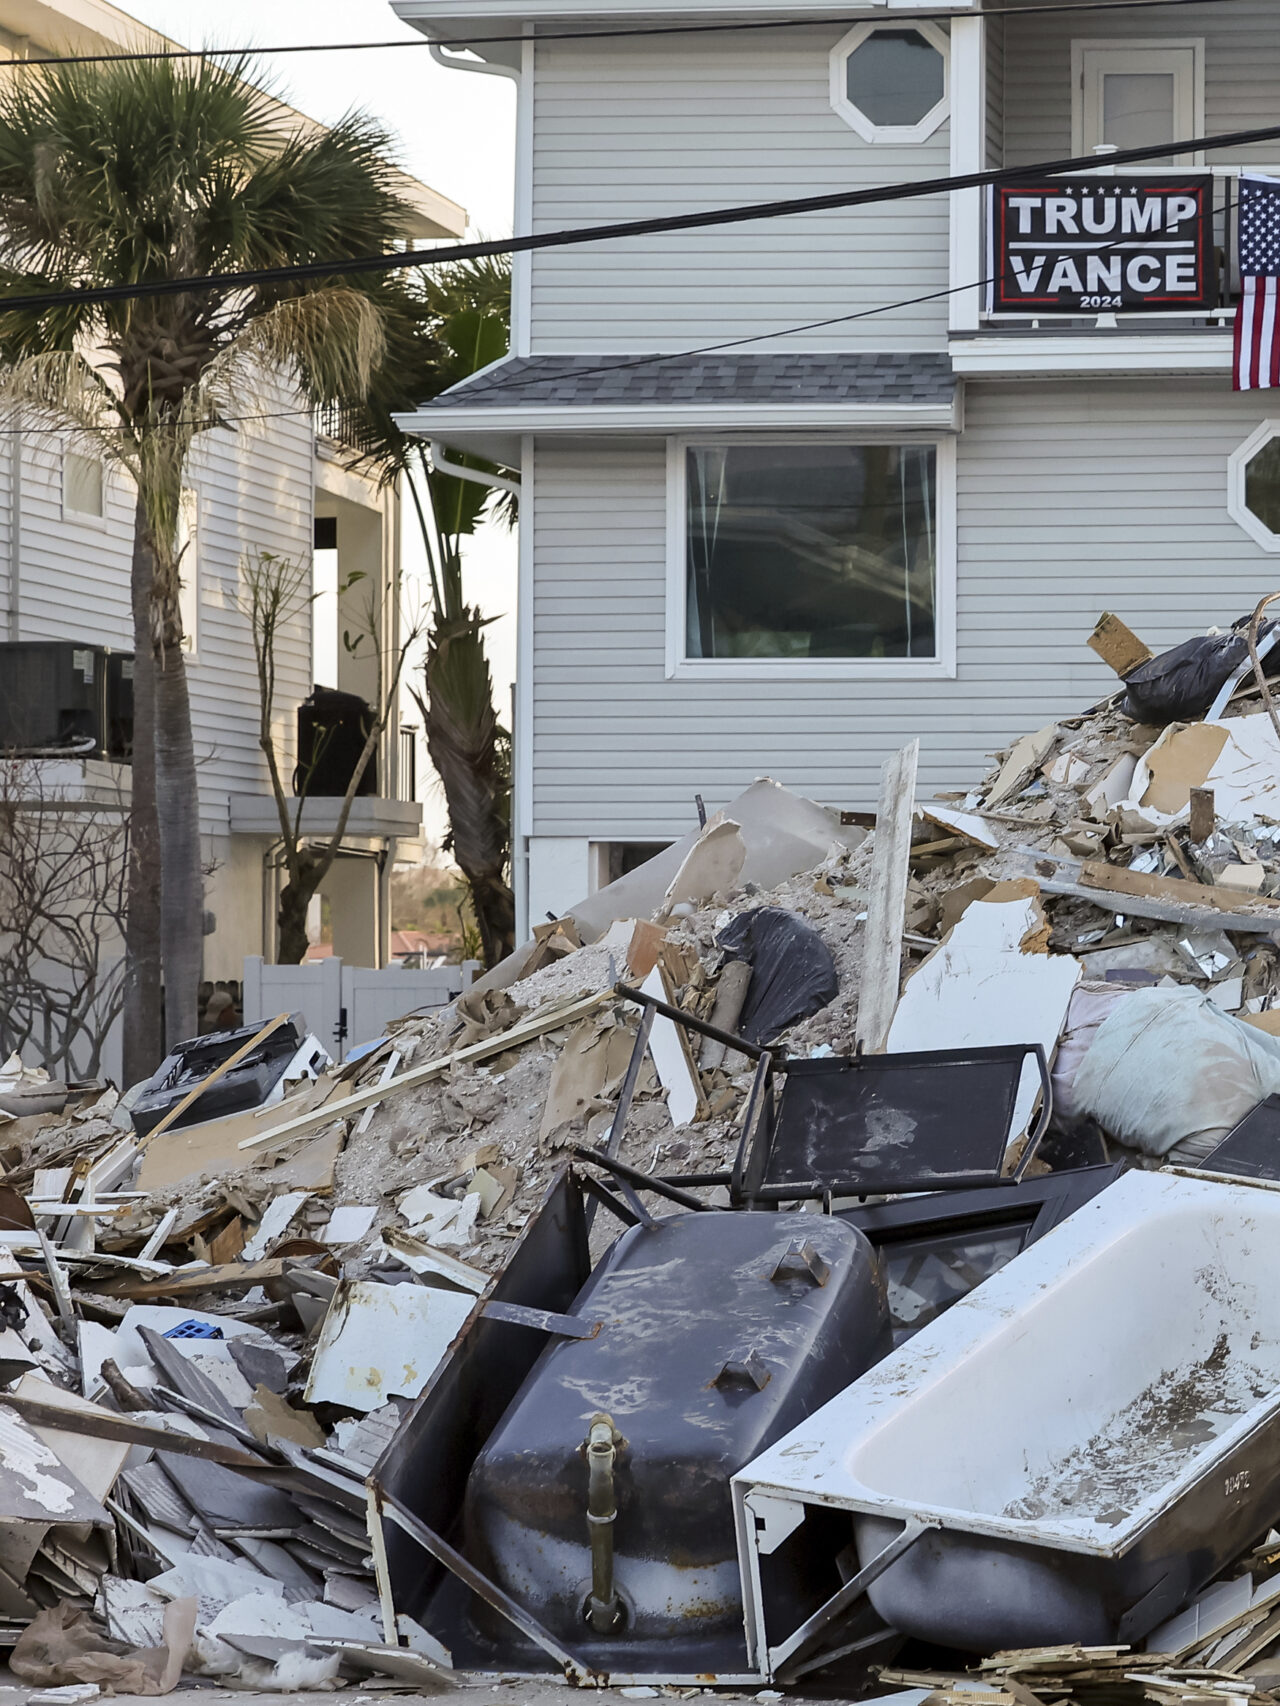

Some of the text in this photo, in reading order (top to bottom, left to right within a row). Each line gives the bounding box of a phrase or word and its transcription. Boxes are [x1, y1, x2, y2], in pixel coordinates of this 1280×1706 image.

[1008, 196, 1197, 235] TRUMP
[1009, 254, 1197, 293] VANCE
[1079, 295, 1123, 308] 2024
